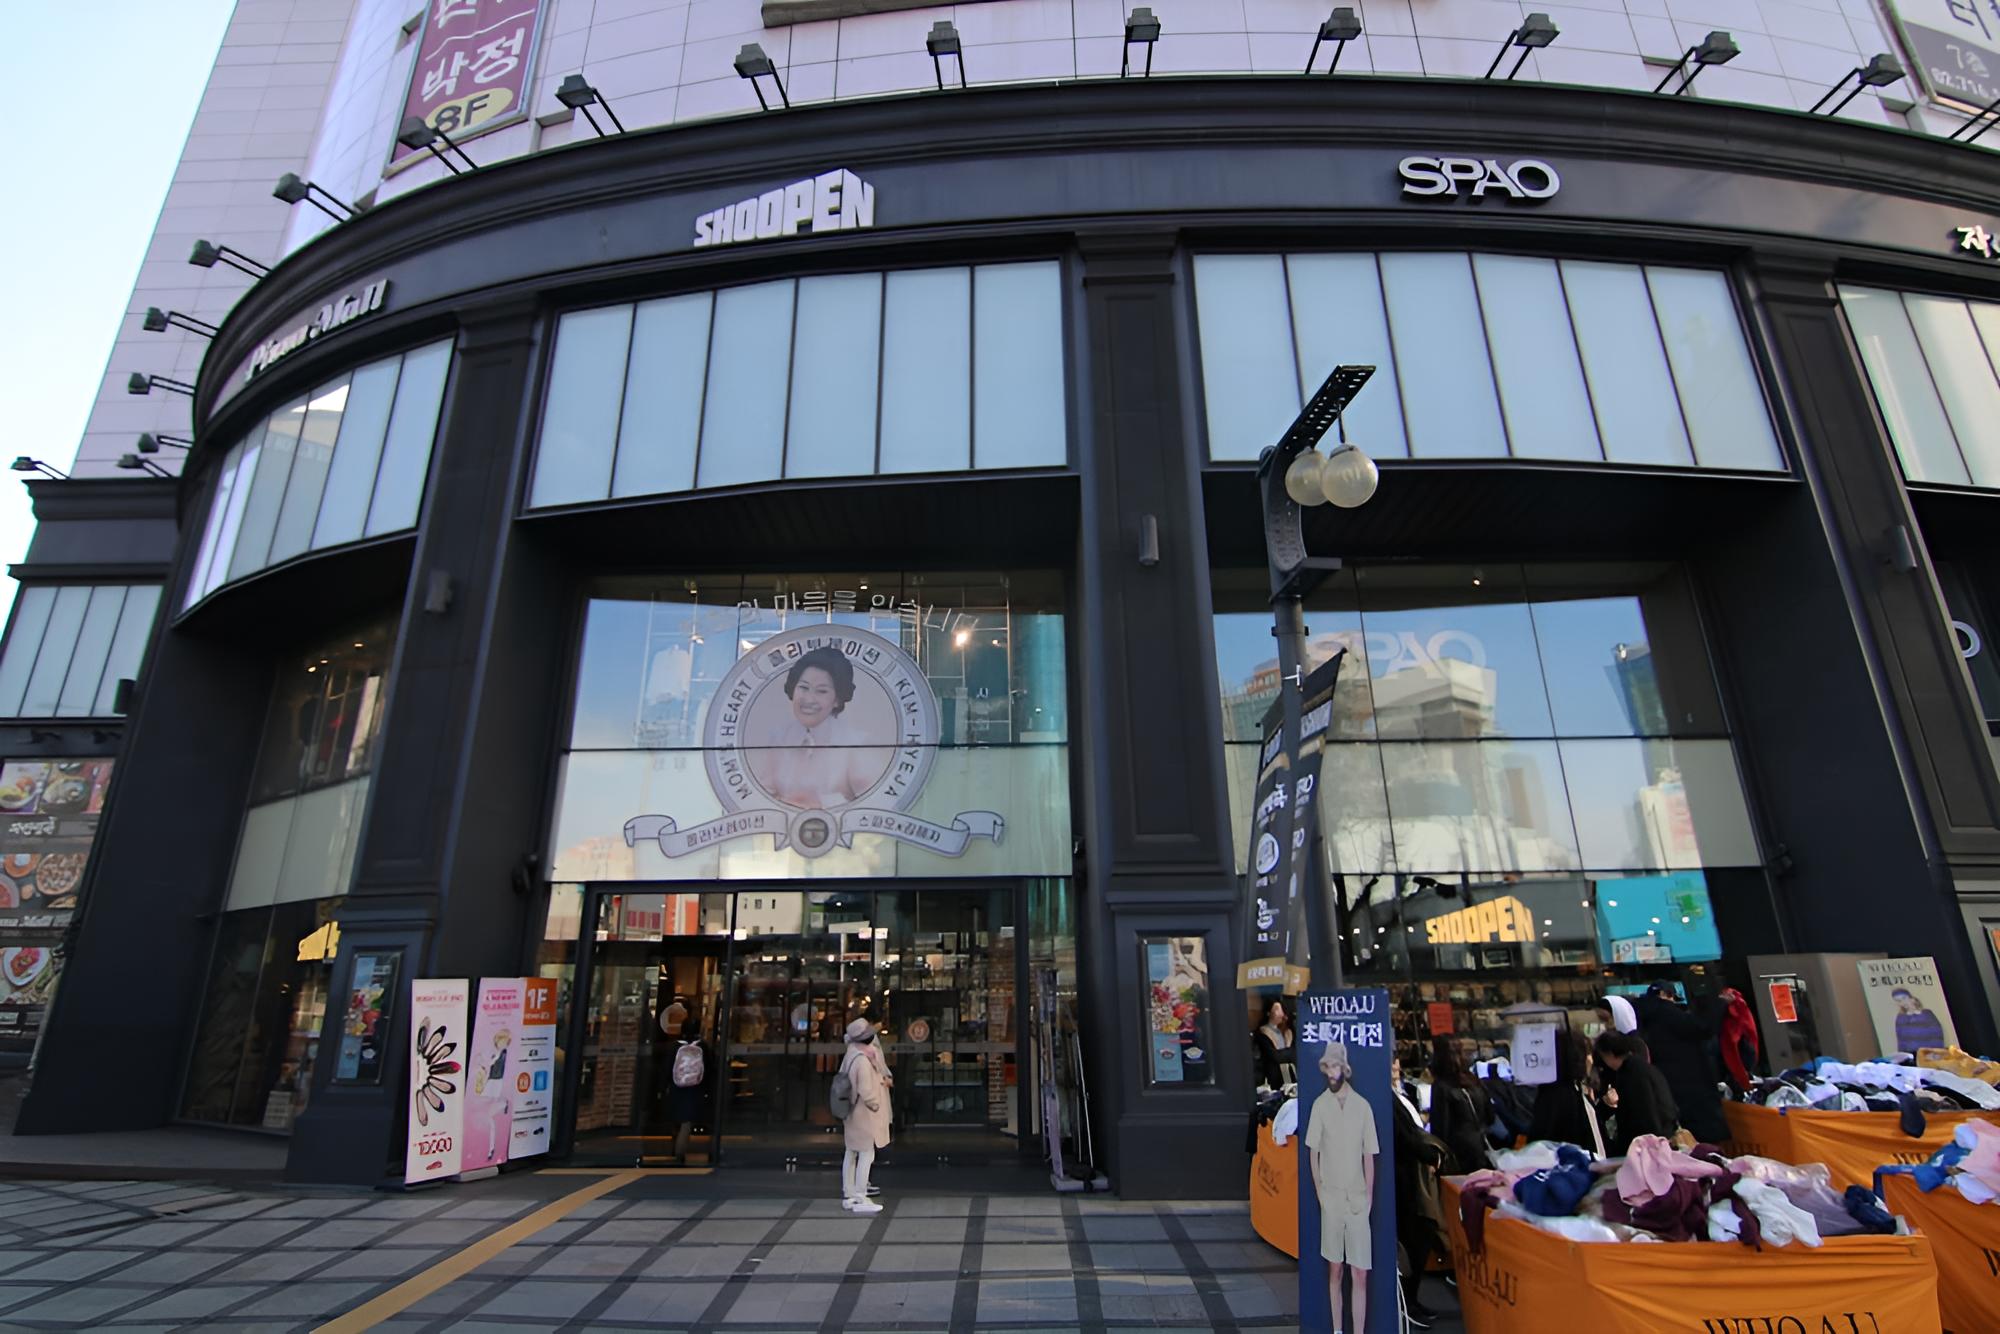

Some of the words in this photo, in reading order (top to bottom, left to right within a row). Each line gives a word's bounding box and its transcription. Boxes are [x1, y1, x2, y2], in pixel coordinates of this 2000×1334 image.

[421, 28, 525, 102] 박정
[435, 94, 490, 132] 8F
[1398, 156, 1560, 198] SPAO
[693, 168, 875, 247] SHOOPEN
[1957, 225, 2000, 260] 자
[721, 680, 752, 736] HEART
[1425, 895, 1535, 944] SHOOPEN
[528, 988, 548, 1009] 1F
[1350, 1022, 1384, 1047] 대전
